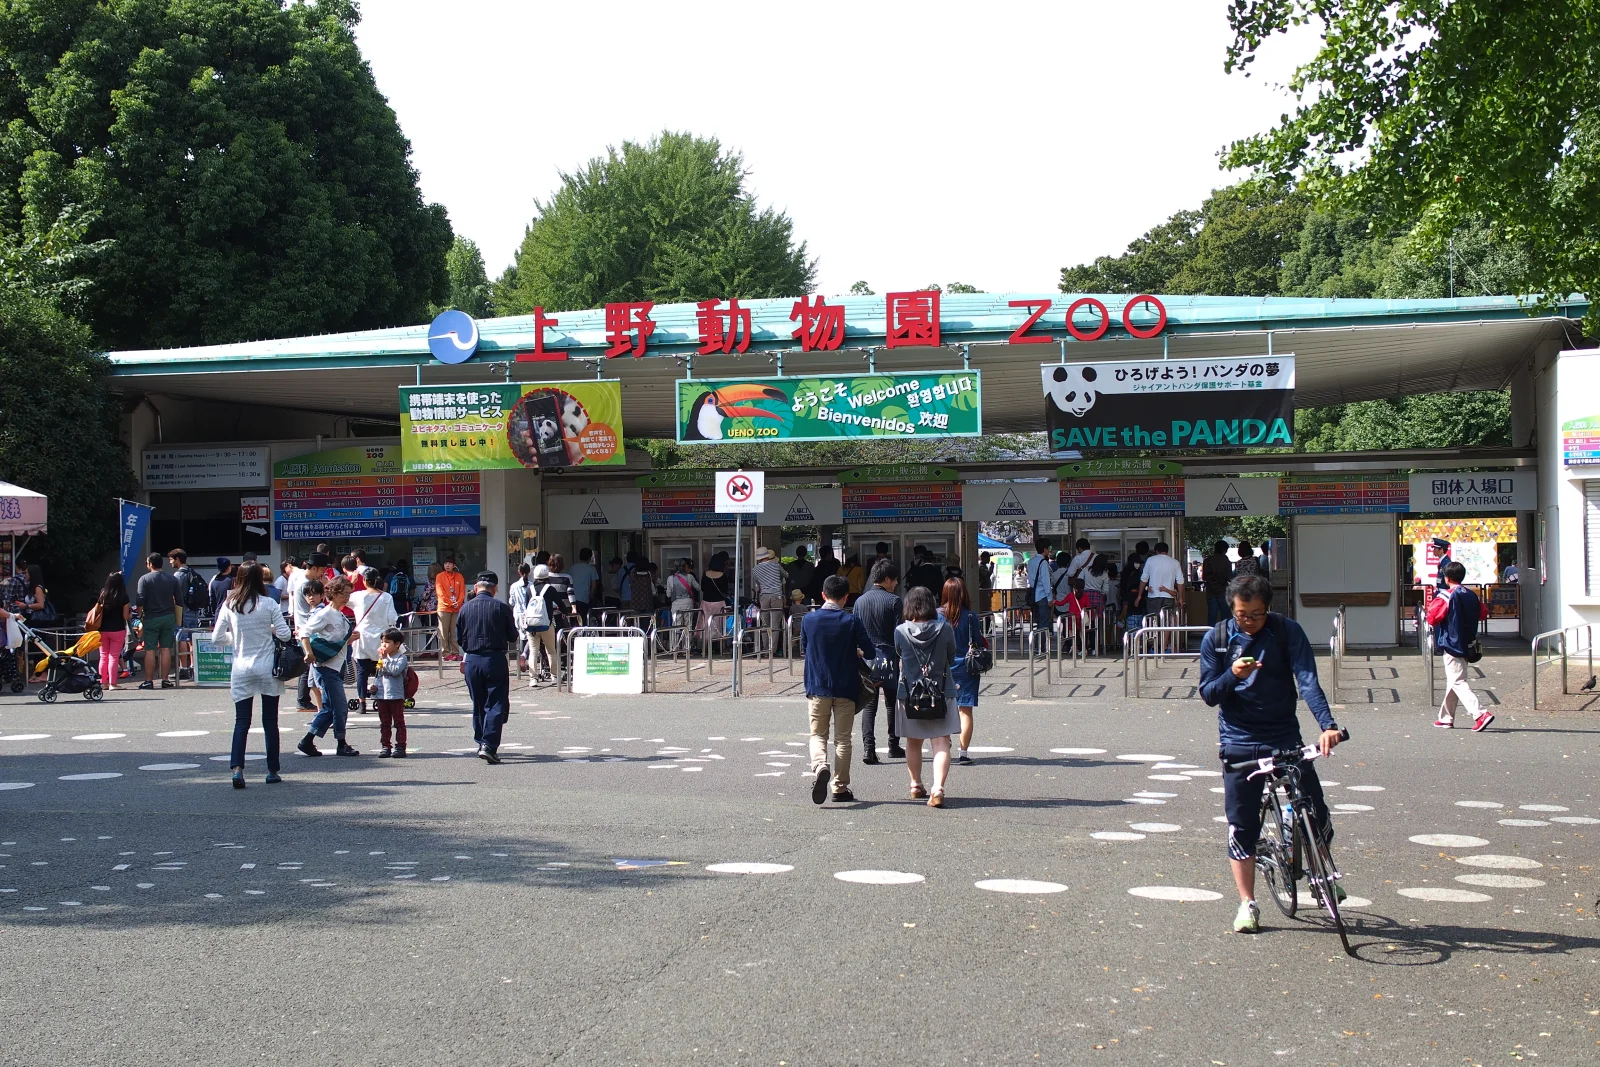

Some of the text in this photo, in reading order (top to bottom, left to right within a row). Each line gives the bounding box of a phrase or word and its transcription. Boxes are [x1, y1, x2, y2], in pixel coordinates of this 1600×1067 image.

[515, 290, 1167, 362] 上野動物園 ZOO
[906, 376, 973, 408] 환영합니다
[1133, 380, 1263, 391] ジャイアントパンダ保護サポート基金
[409, 391, 503, 406] 携帯端末を使った
[791, 382, 848, 412] ようこそ
[847, 379, 920, 409] Welcome
[409, 405, 504, 421] 動物情報サービス
[817, 406, 916, 434] Bienvenidos
[918, 411, 949, 430] 欢迎
[727, 427, 778, 437] UENO ZOO
[1052, 417, 1293, 448] SAVE the PANDA
[282, 463, 309, 475] 入園料
[312, 462, 361, 474] Admission
[865, 465, 928, 476] チケット販売機
[1085, 459, 1152, 470] チケット販売機
[1431, 478, 1514, 495] 団体入場口
[1433, 495, 1513, 506] GROUP ENTRANCE
[242, 504, 269, 520] 窓口
